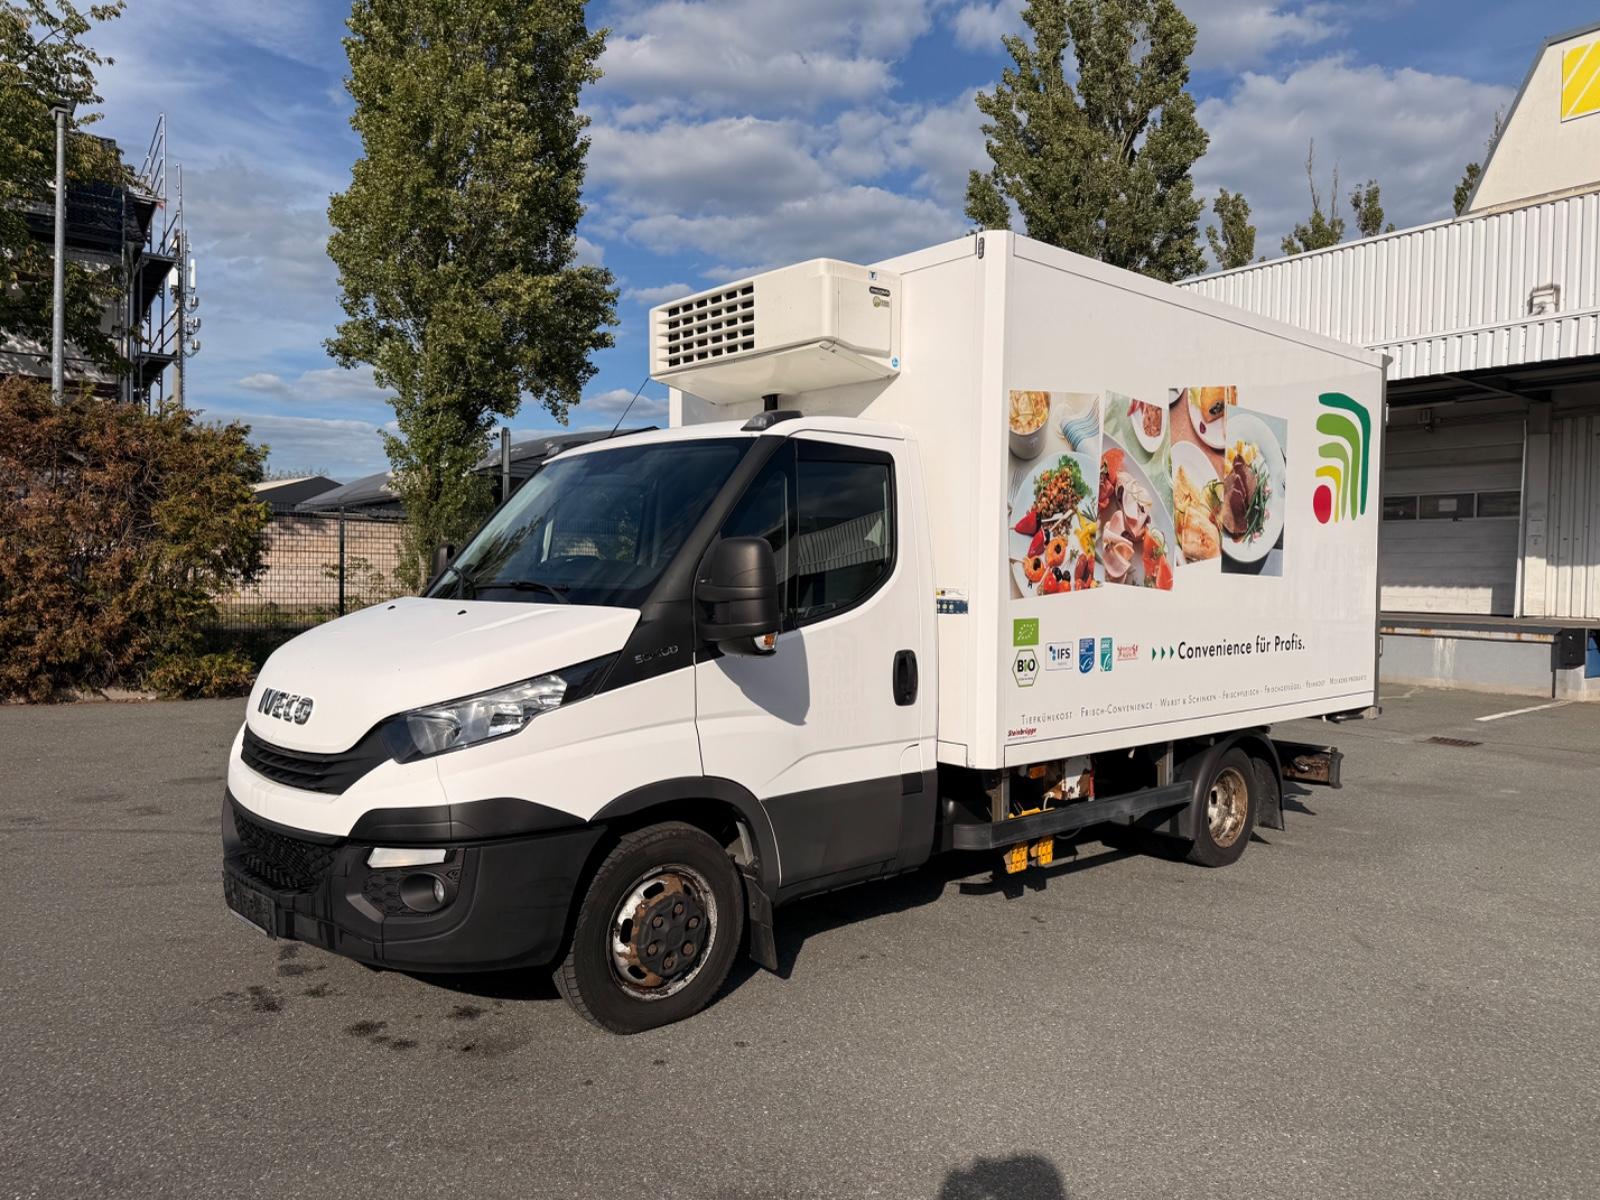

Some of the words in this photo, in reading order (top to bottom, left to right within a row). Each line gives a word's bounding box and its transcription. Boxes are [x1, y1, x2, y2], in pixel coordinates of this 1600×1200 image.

[1057, 647, 1070, 660] IFS
[1178, 639, 1252, 659] Convenience
[1256, 635, 1271, 653] für
[1275, 633, 1305, 652] Profis.
[258, 687, 314, 725] IVECO
